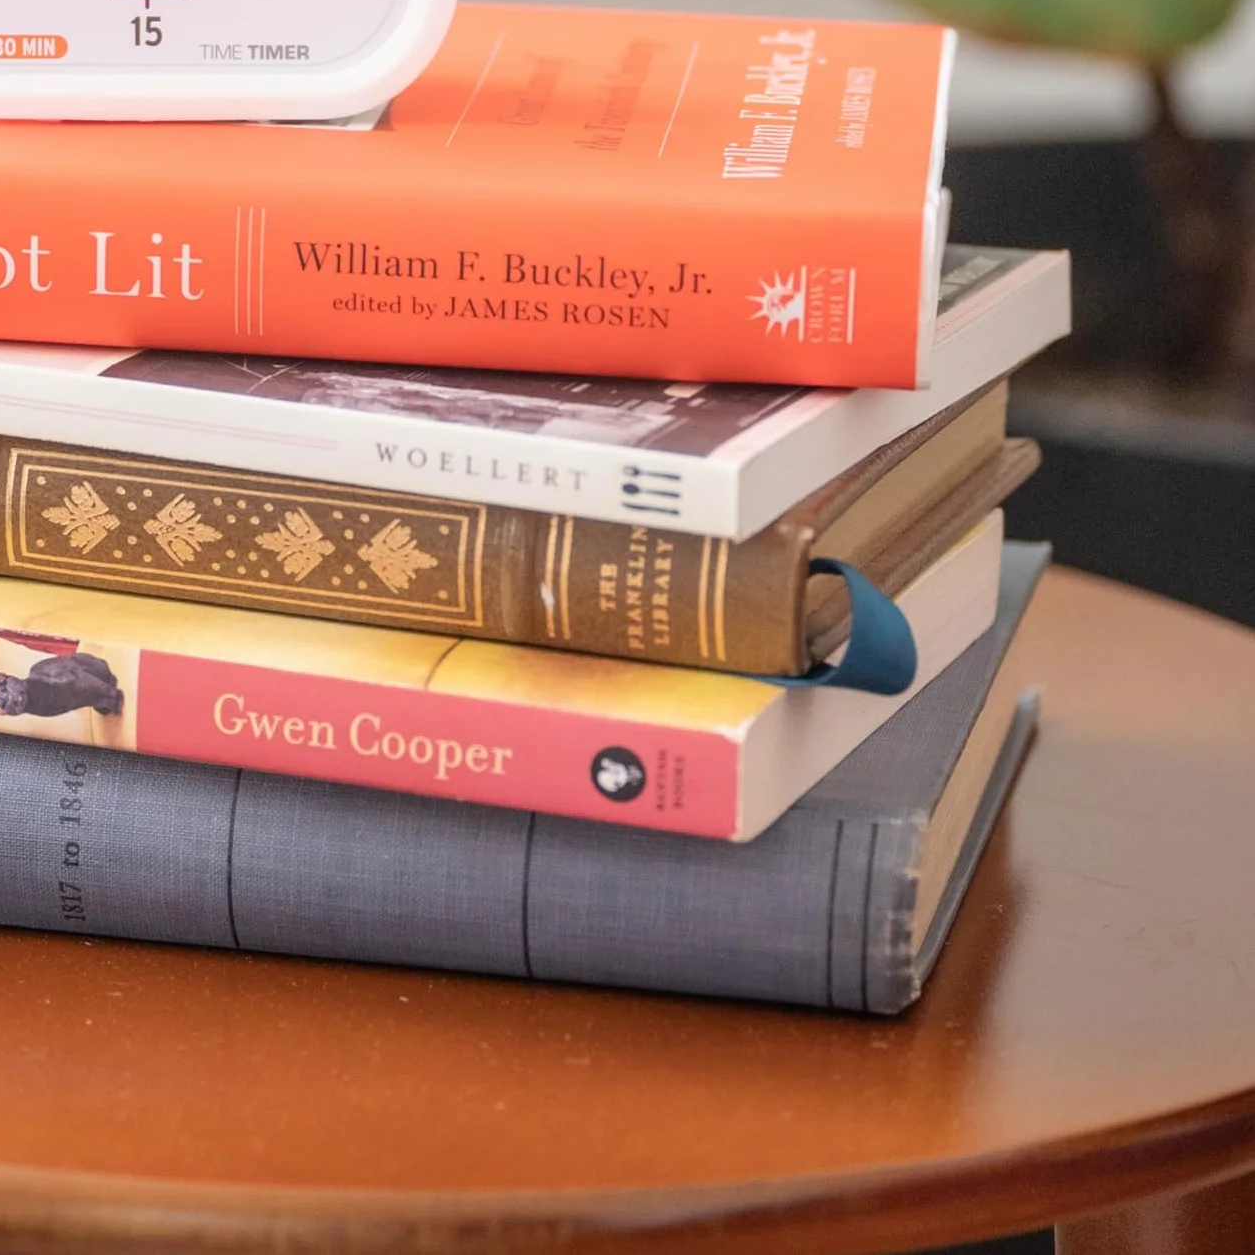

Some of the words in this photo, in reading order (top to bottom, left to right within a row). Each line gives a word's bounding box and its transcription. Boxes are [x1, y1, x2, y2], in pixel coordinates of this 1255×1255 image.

[22, 38, 56, 57] MIN
[130, 16, 163, 47] 15
[199, 44, 243, 61] TIME
[247, 44, 310, 61] TIMER
[722, 124, 795, 179] William
[87, 230, 205, 301] Lit
[293, 241, 438, 280] William
[456, 250, 486, 282] F.
[503, 252, 655, 299] Buckley,
[668, 261, 713, 295] Jr.
[332, 292, 402, 315] edited
[411, 296, 437, 320] by
[444, 296, 549, 322] JAMES
[561, 302, 671, 329] ROSEN
[374, 442, 590, 493] WOELLERT
[599, 563, 618, 612] THE
[652, 538, 674, 646] LIBRARY
[213, 693, 337, 750] Gwen
[349, 711, 514, 781] Cooper
[59, 759, 88, 827] 1846
[62, 839, 82, 867] to
[60, 880, 86, 922] 1817
